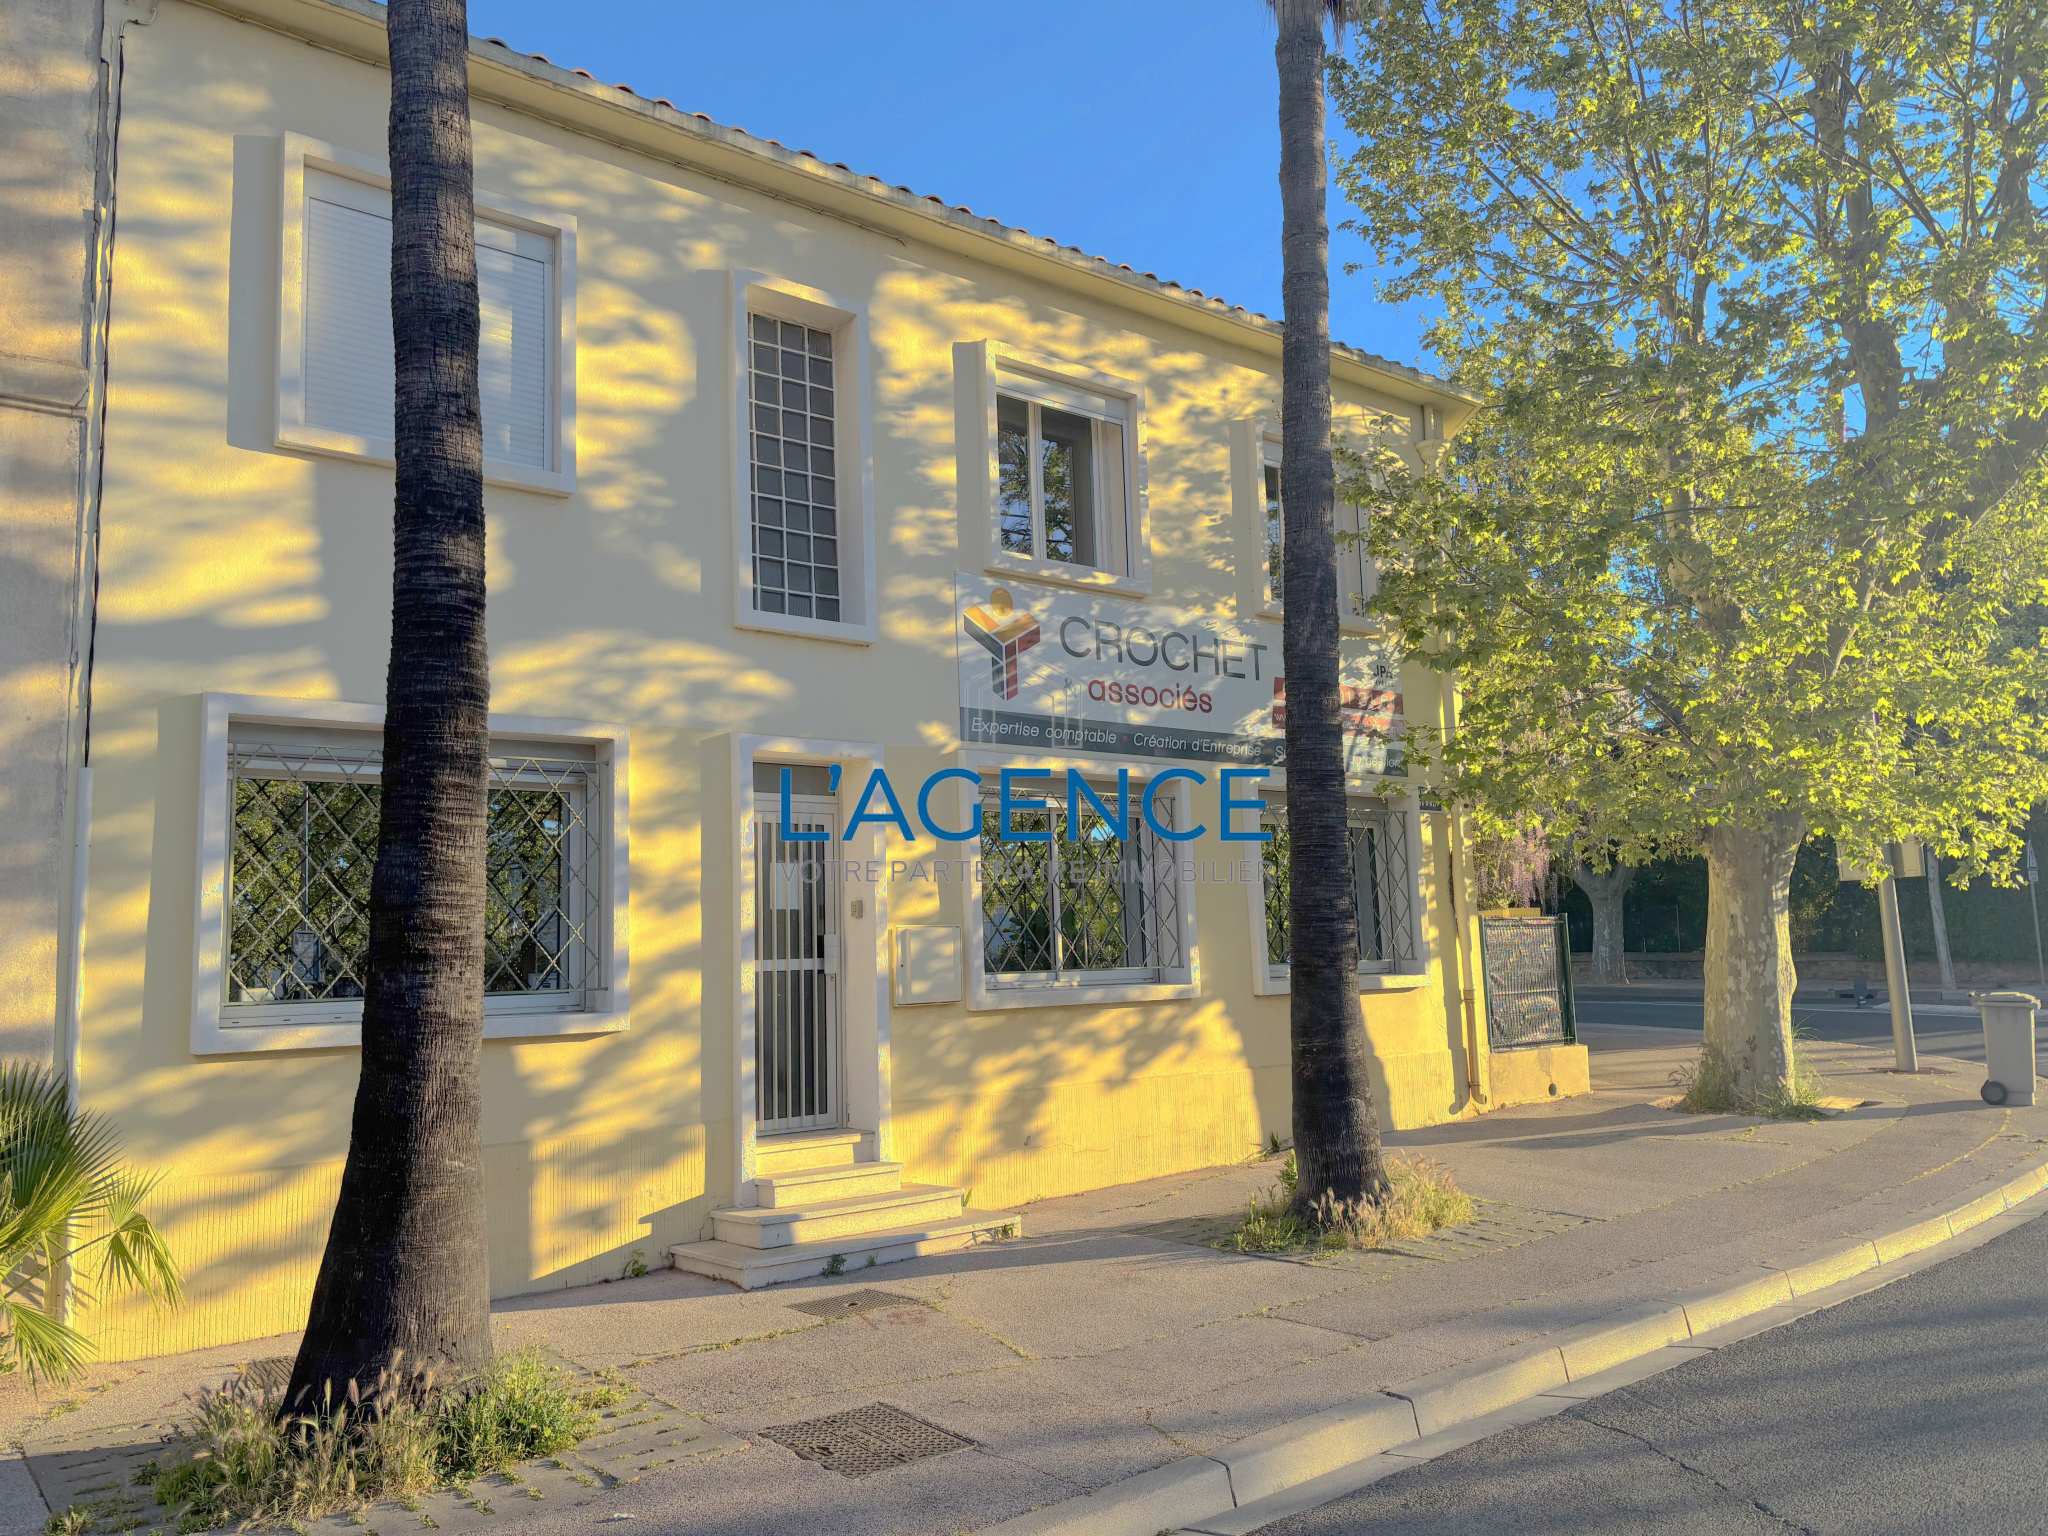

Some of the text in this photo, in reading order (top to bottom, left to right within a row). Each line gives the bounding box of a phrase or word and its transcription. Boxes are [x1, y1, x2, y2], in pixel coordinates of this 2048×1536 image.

[1059, 616, 1268, 681] CROCHET
[1088, 679, 1213, 713] associés
[971, 717, 1040, 737] Expertise
[1045, 727, 1117, 744] comptable
[1133, 732, 1187, 750] Création
[1192, 738, 1261, 757] d'Entreprise
